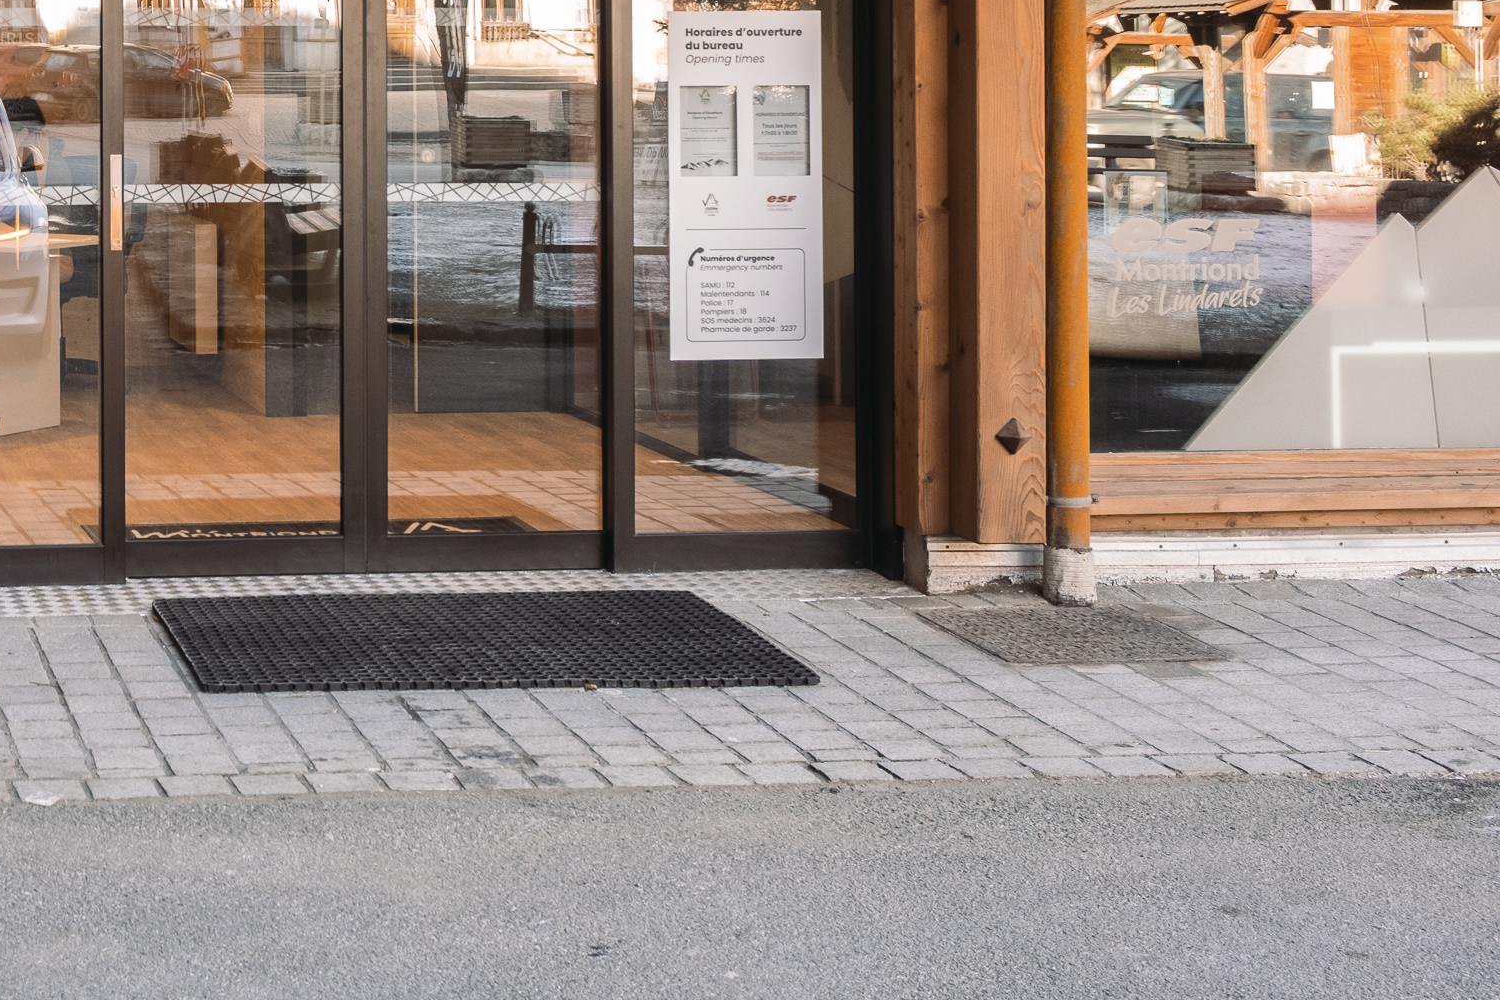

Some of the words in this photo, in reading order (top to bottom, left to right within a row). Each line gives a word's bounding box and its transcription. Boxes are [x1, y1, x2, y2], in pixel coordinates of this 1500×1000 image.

[685, 27, 733, 37] Horaires
[735, 28, 803, 37] d'ouverture
[685, 41, 700, 50] du
[702, 41, 743, 50] bureau
[685, 54, 732, 66] Opening
[735, 54, 765, 63] times
[1115, 254, 1260, 281] Montriond
[1108, 287, 1152, 318] Les
[1159, 281, 1263, 316] Lindarets
[753, 326, 775, 334] garde
